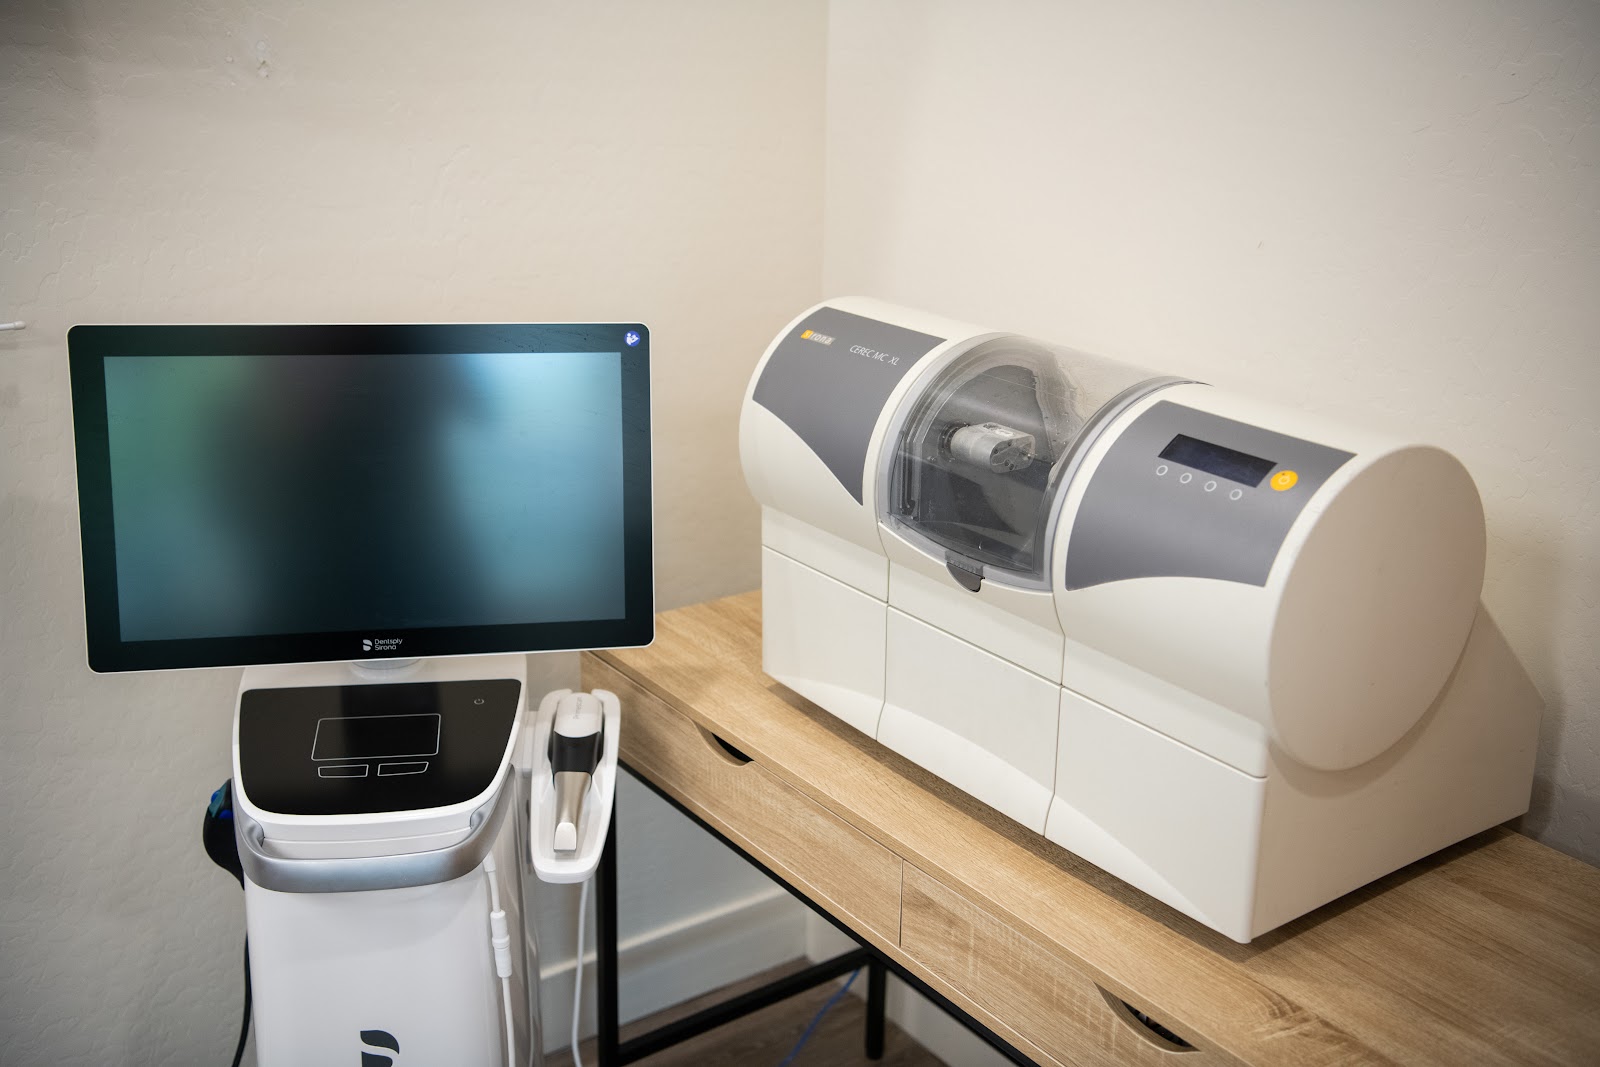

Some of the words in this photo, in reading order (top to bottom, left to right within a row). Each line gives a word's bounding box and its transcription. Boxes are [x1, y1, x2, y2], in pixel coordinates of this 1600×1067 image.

[849, 344, 875, 358] CEREC
[872, 351, 889, 362] MC
[888, 357, 900, 366] XL
